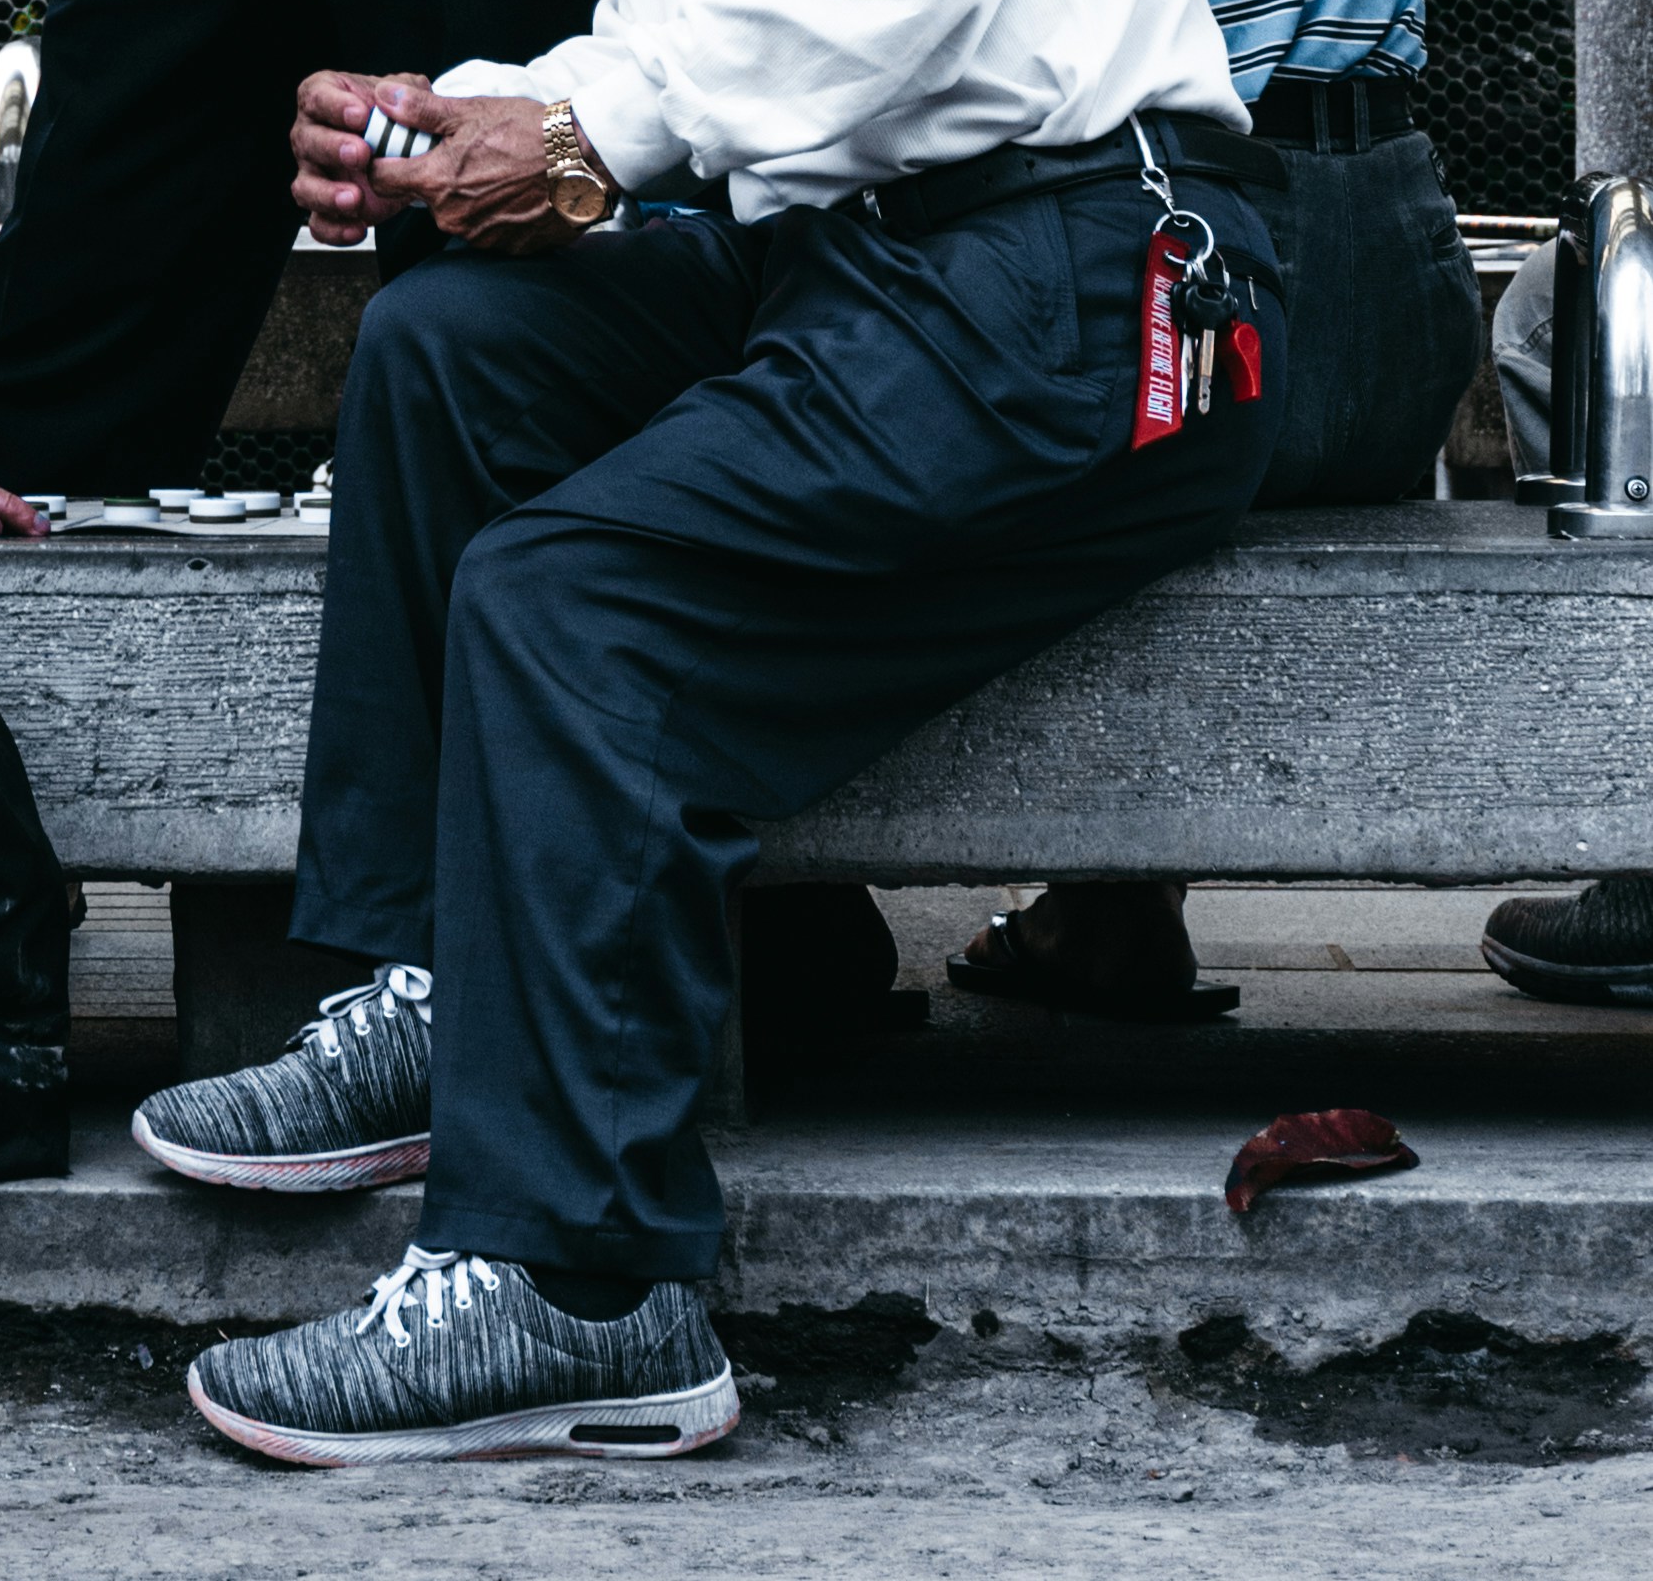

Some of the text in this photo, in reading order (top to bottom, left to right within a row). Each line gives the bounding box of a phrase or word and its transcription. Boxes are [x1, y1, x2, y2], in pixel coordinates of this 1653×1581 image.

[1147, 274, 1173, 424] REMOVE BEFORE FLIGHT
